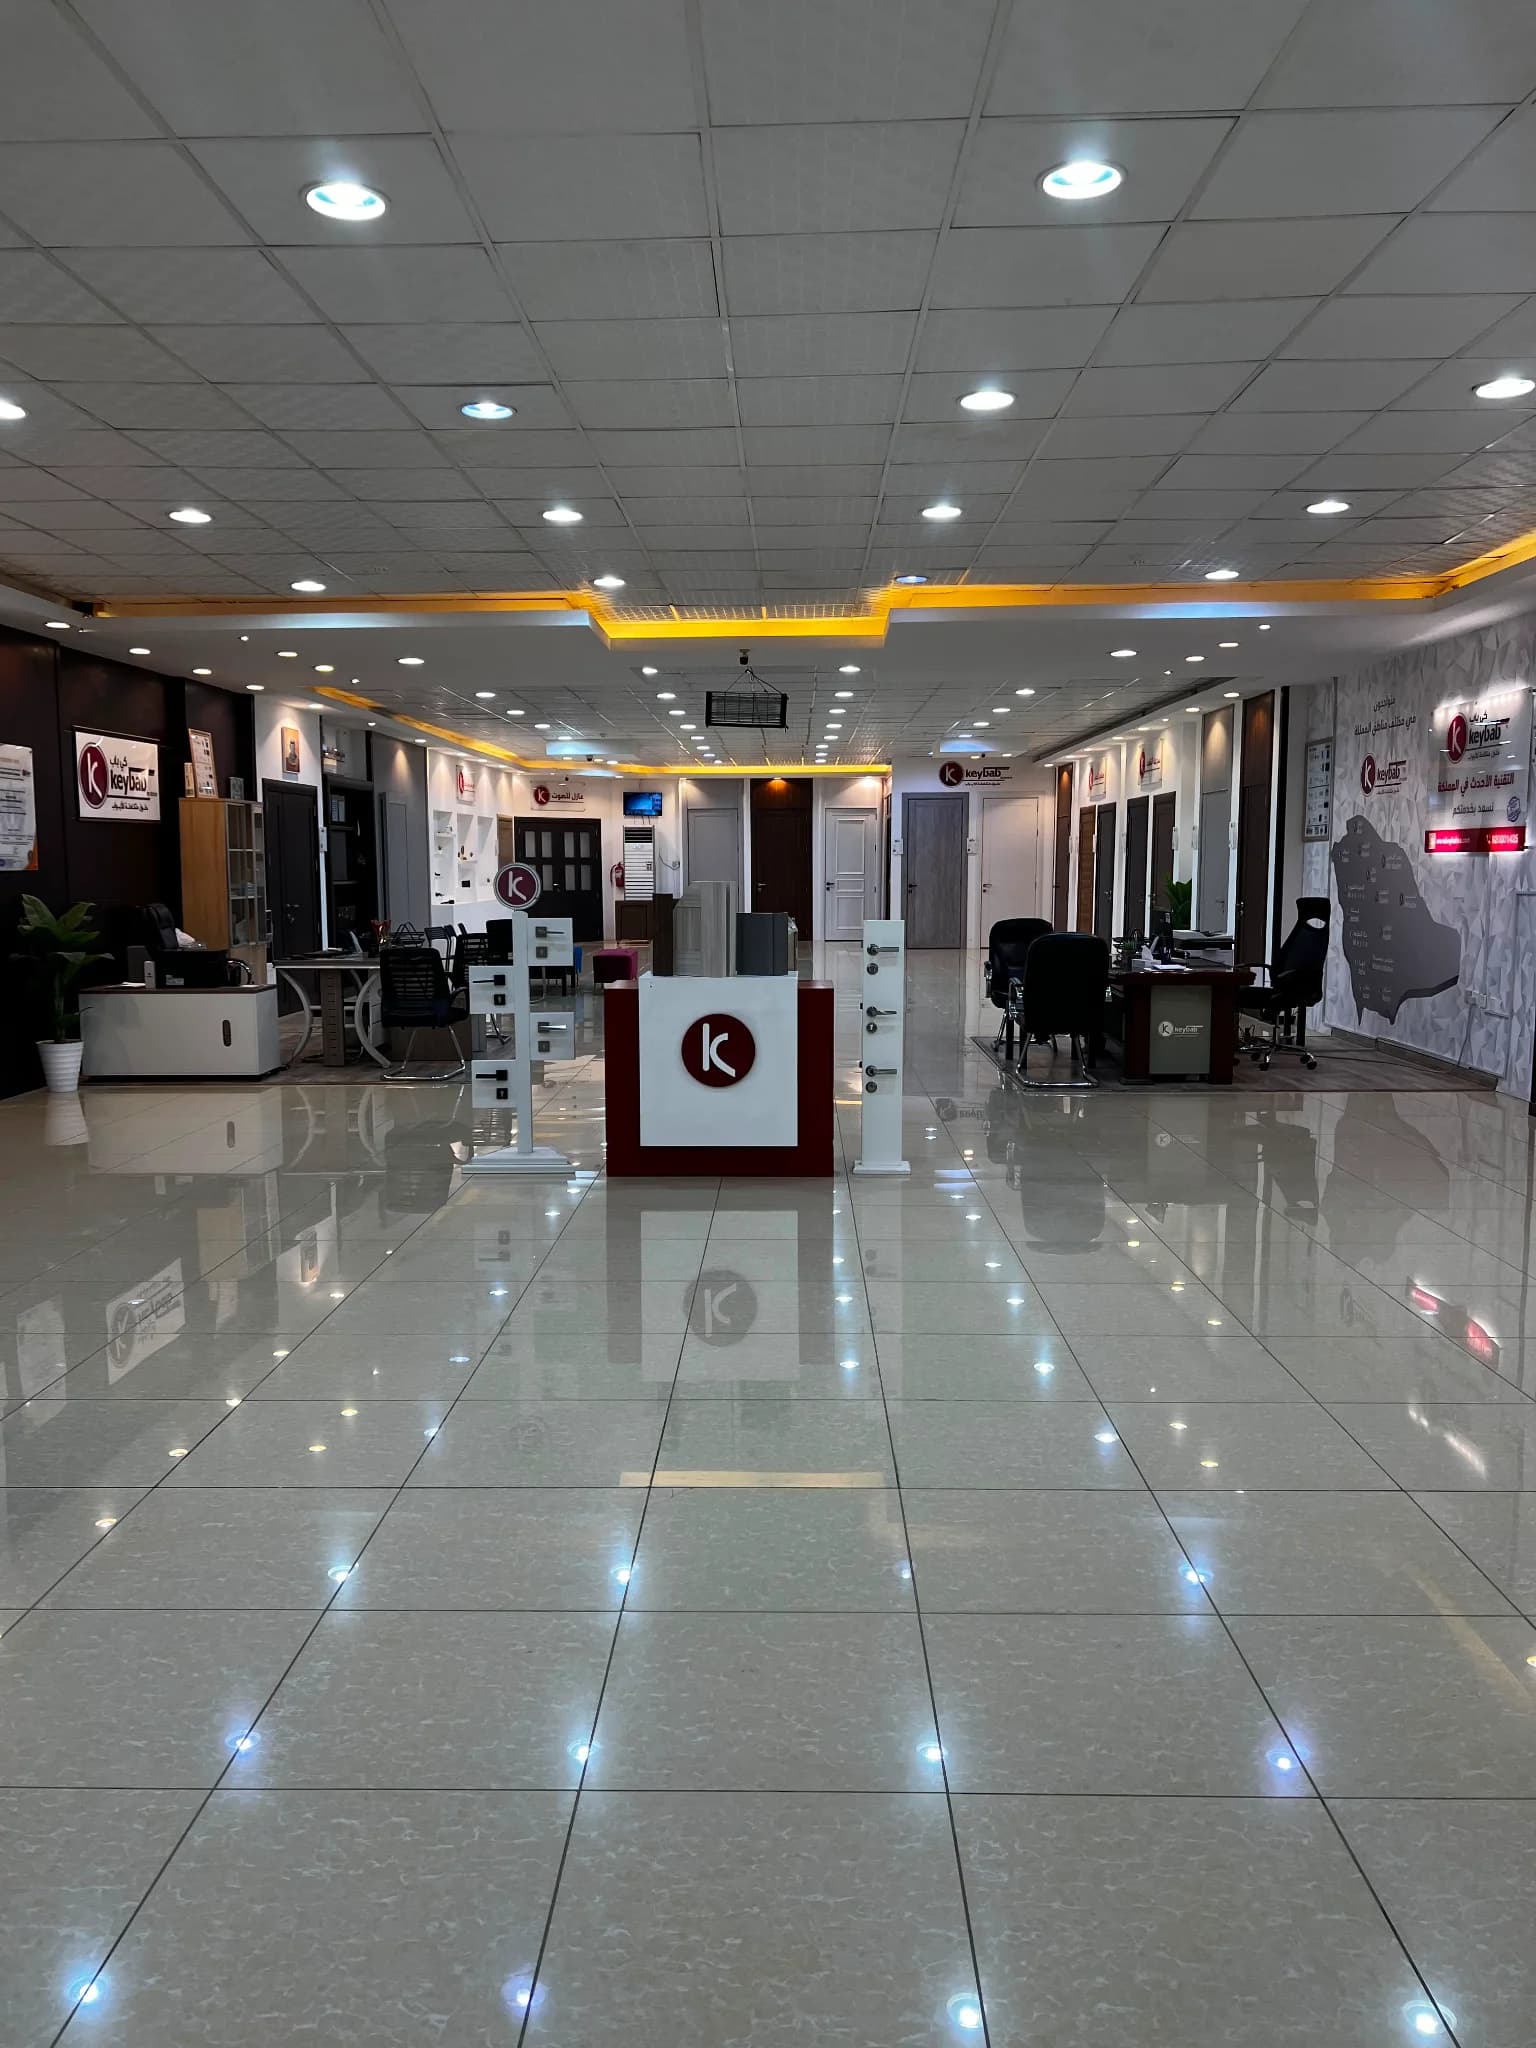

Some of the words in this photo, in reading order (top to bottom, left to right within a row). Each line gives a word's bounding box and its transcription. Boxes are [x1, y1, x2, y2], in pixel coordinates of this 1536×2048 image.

[1405, 713, 1416, 731] في
[1469, 718, 1510, 746] keybab
[110, 767, 154, 795] keybab
[965, 767, 1010, 780] keybab
[1376, 760, 1406, 784] keybab
[1470, 773, 1492, 788] الأحدث
[1494, 772, 1515, 789] التقنية
[1438, 778, 1460, 793] المملكة
[1460, 776, 1469, 797] في
